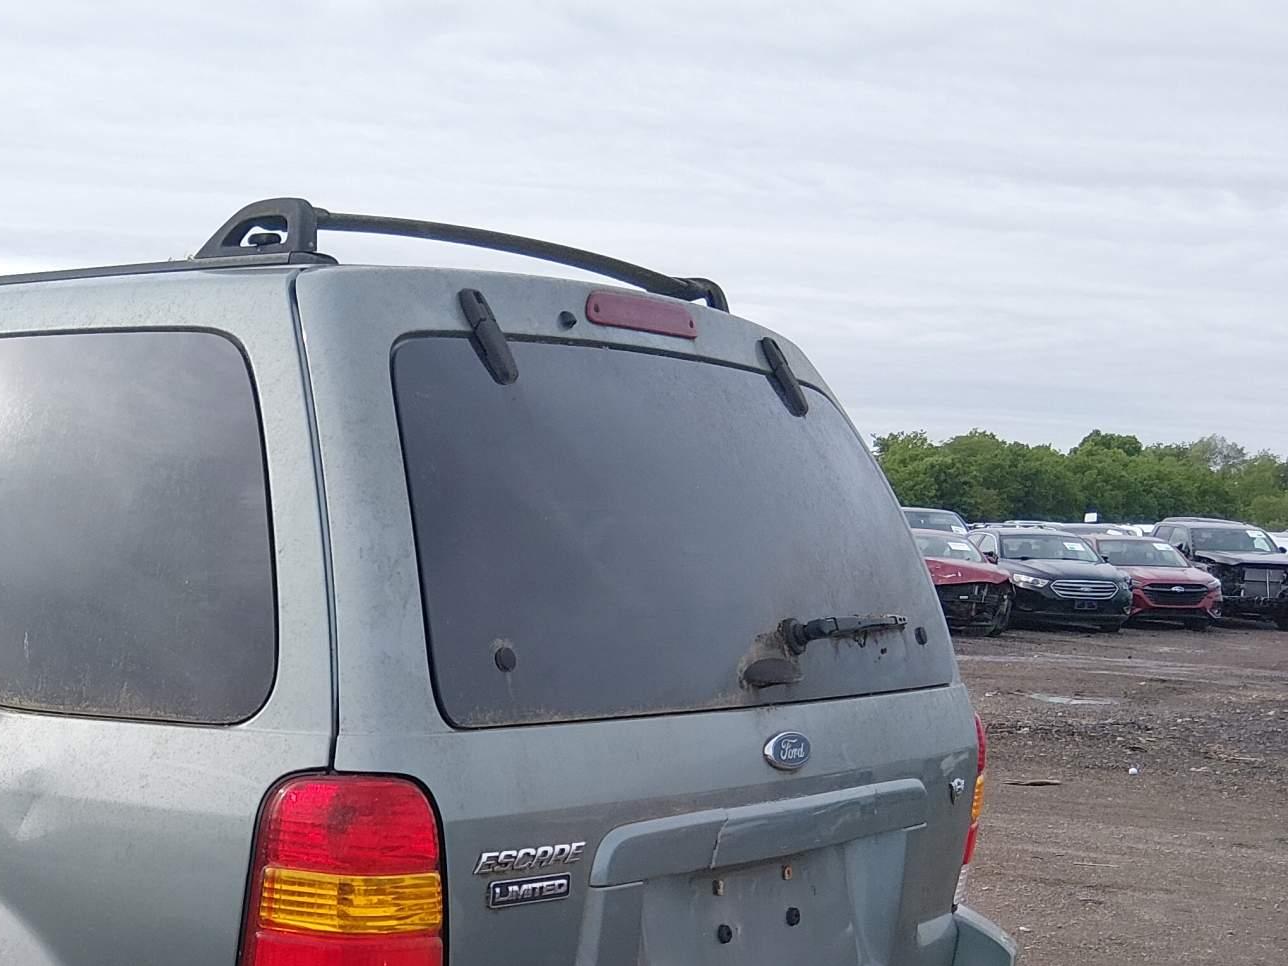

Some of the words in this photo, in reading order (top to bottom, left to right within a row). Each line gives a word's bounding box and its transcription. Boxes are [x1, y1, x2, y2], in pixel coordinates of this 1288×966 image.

[780, 738, 805, 760] Ford
[473, 841, 587, 874] ESCAPE
[494, 879, 568, 902] LIMITED
